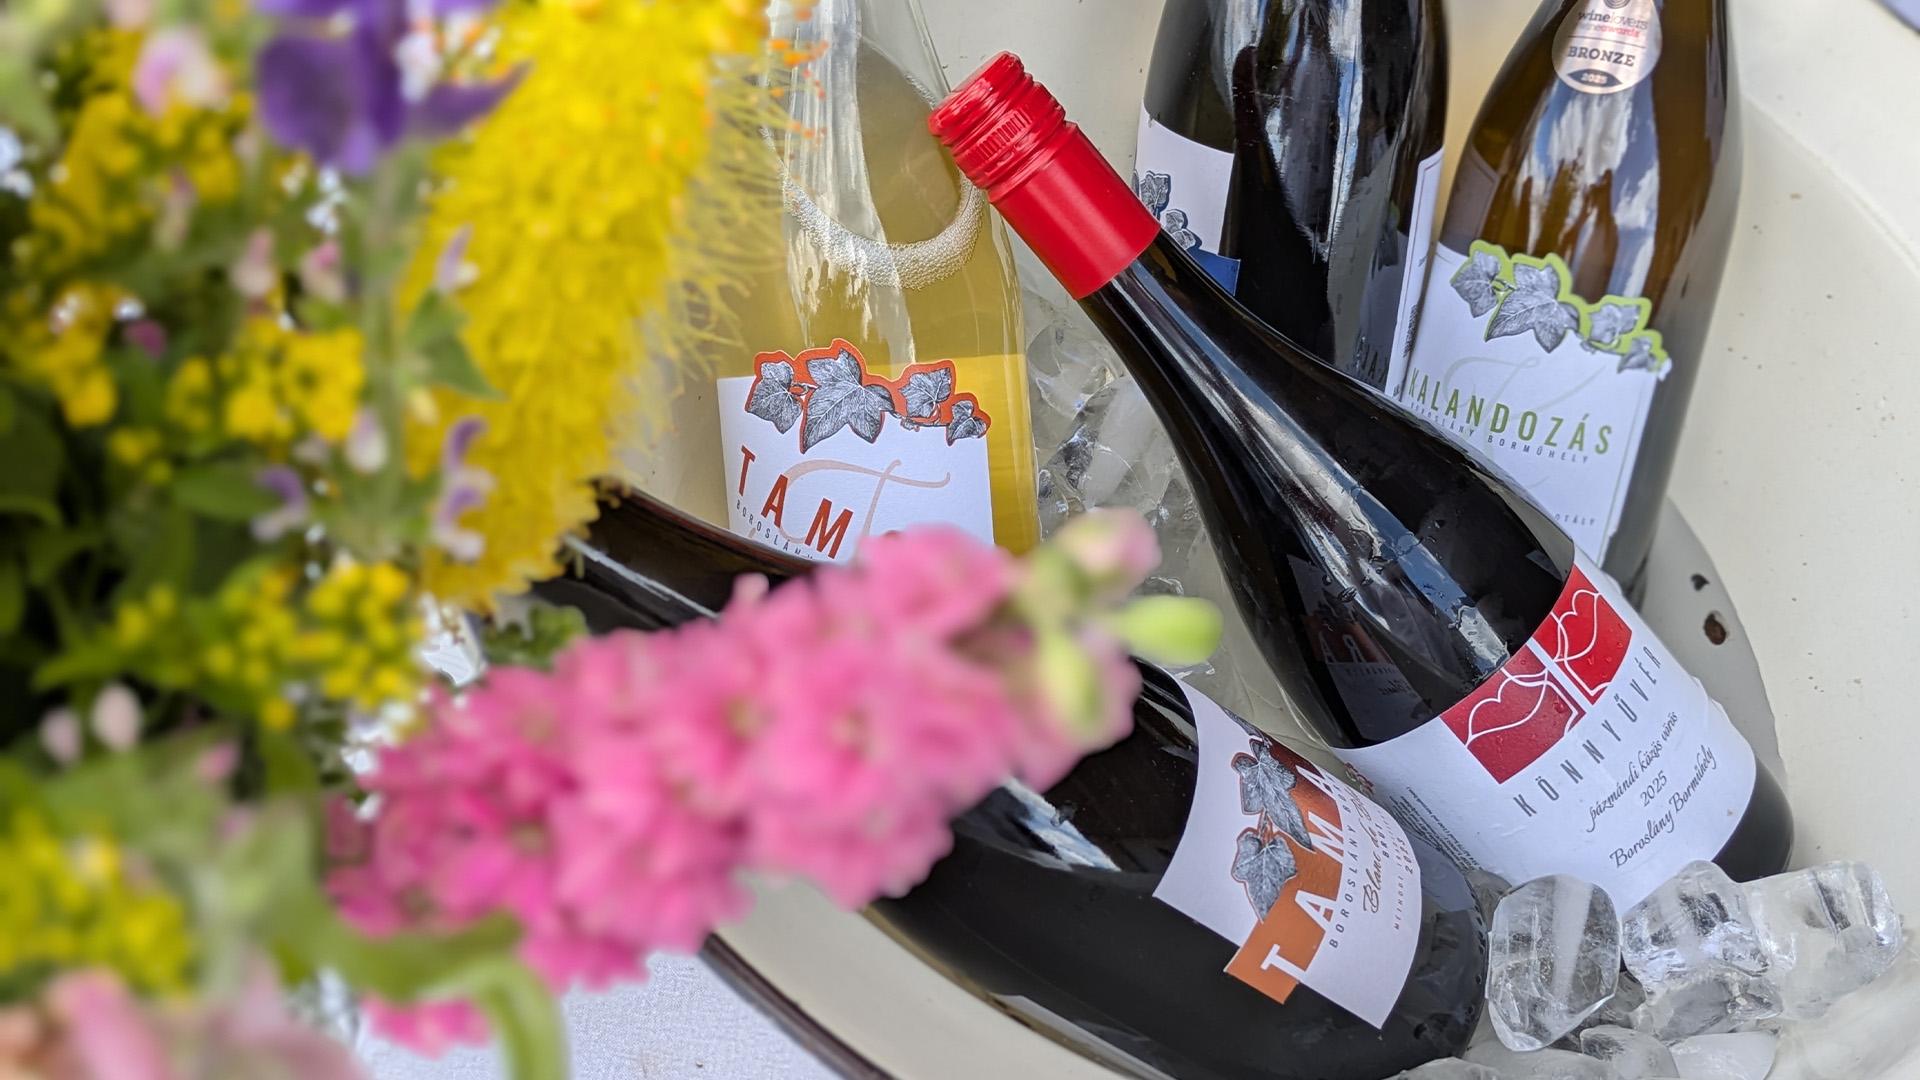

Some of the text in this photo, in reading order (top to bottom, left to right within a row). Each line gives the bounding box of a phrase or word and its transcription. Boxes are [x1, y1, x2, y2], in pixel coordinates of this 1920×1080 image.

[1567, 46, 1636, 67] BRONZE
[1408, 367, 1613, 455] KALANDOZÁS
[736, 500, 813, 560] BOROSLÁN
[739, 445, 900, 560] TAM
[1513, 646, 1662, 818] KÖNNYŰVÉR
[1586, 711, 1679, 833] pázmándi közös vörös
[1609, 744, 1717, 869] Boroslány Borműhely
[1639, 769, 1668, 808] 2025
[1363, 850, 1384, 915] Blanc
